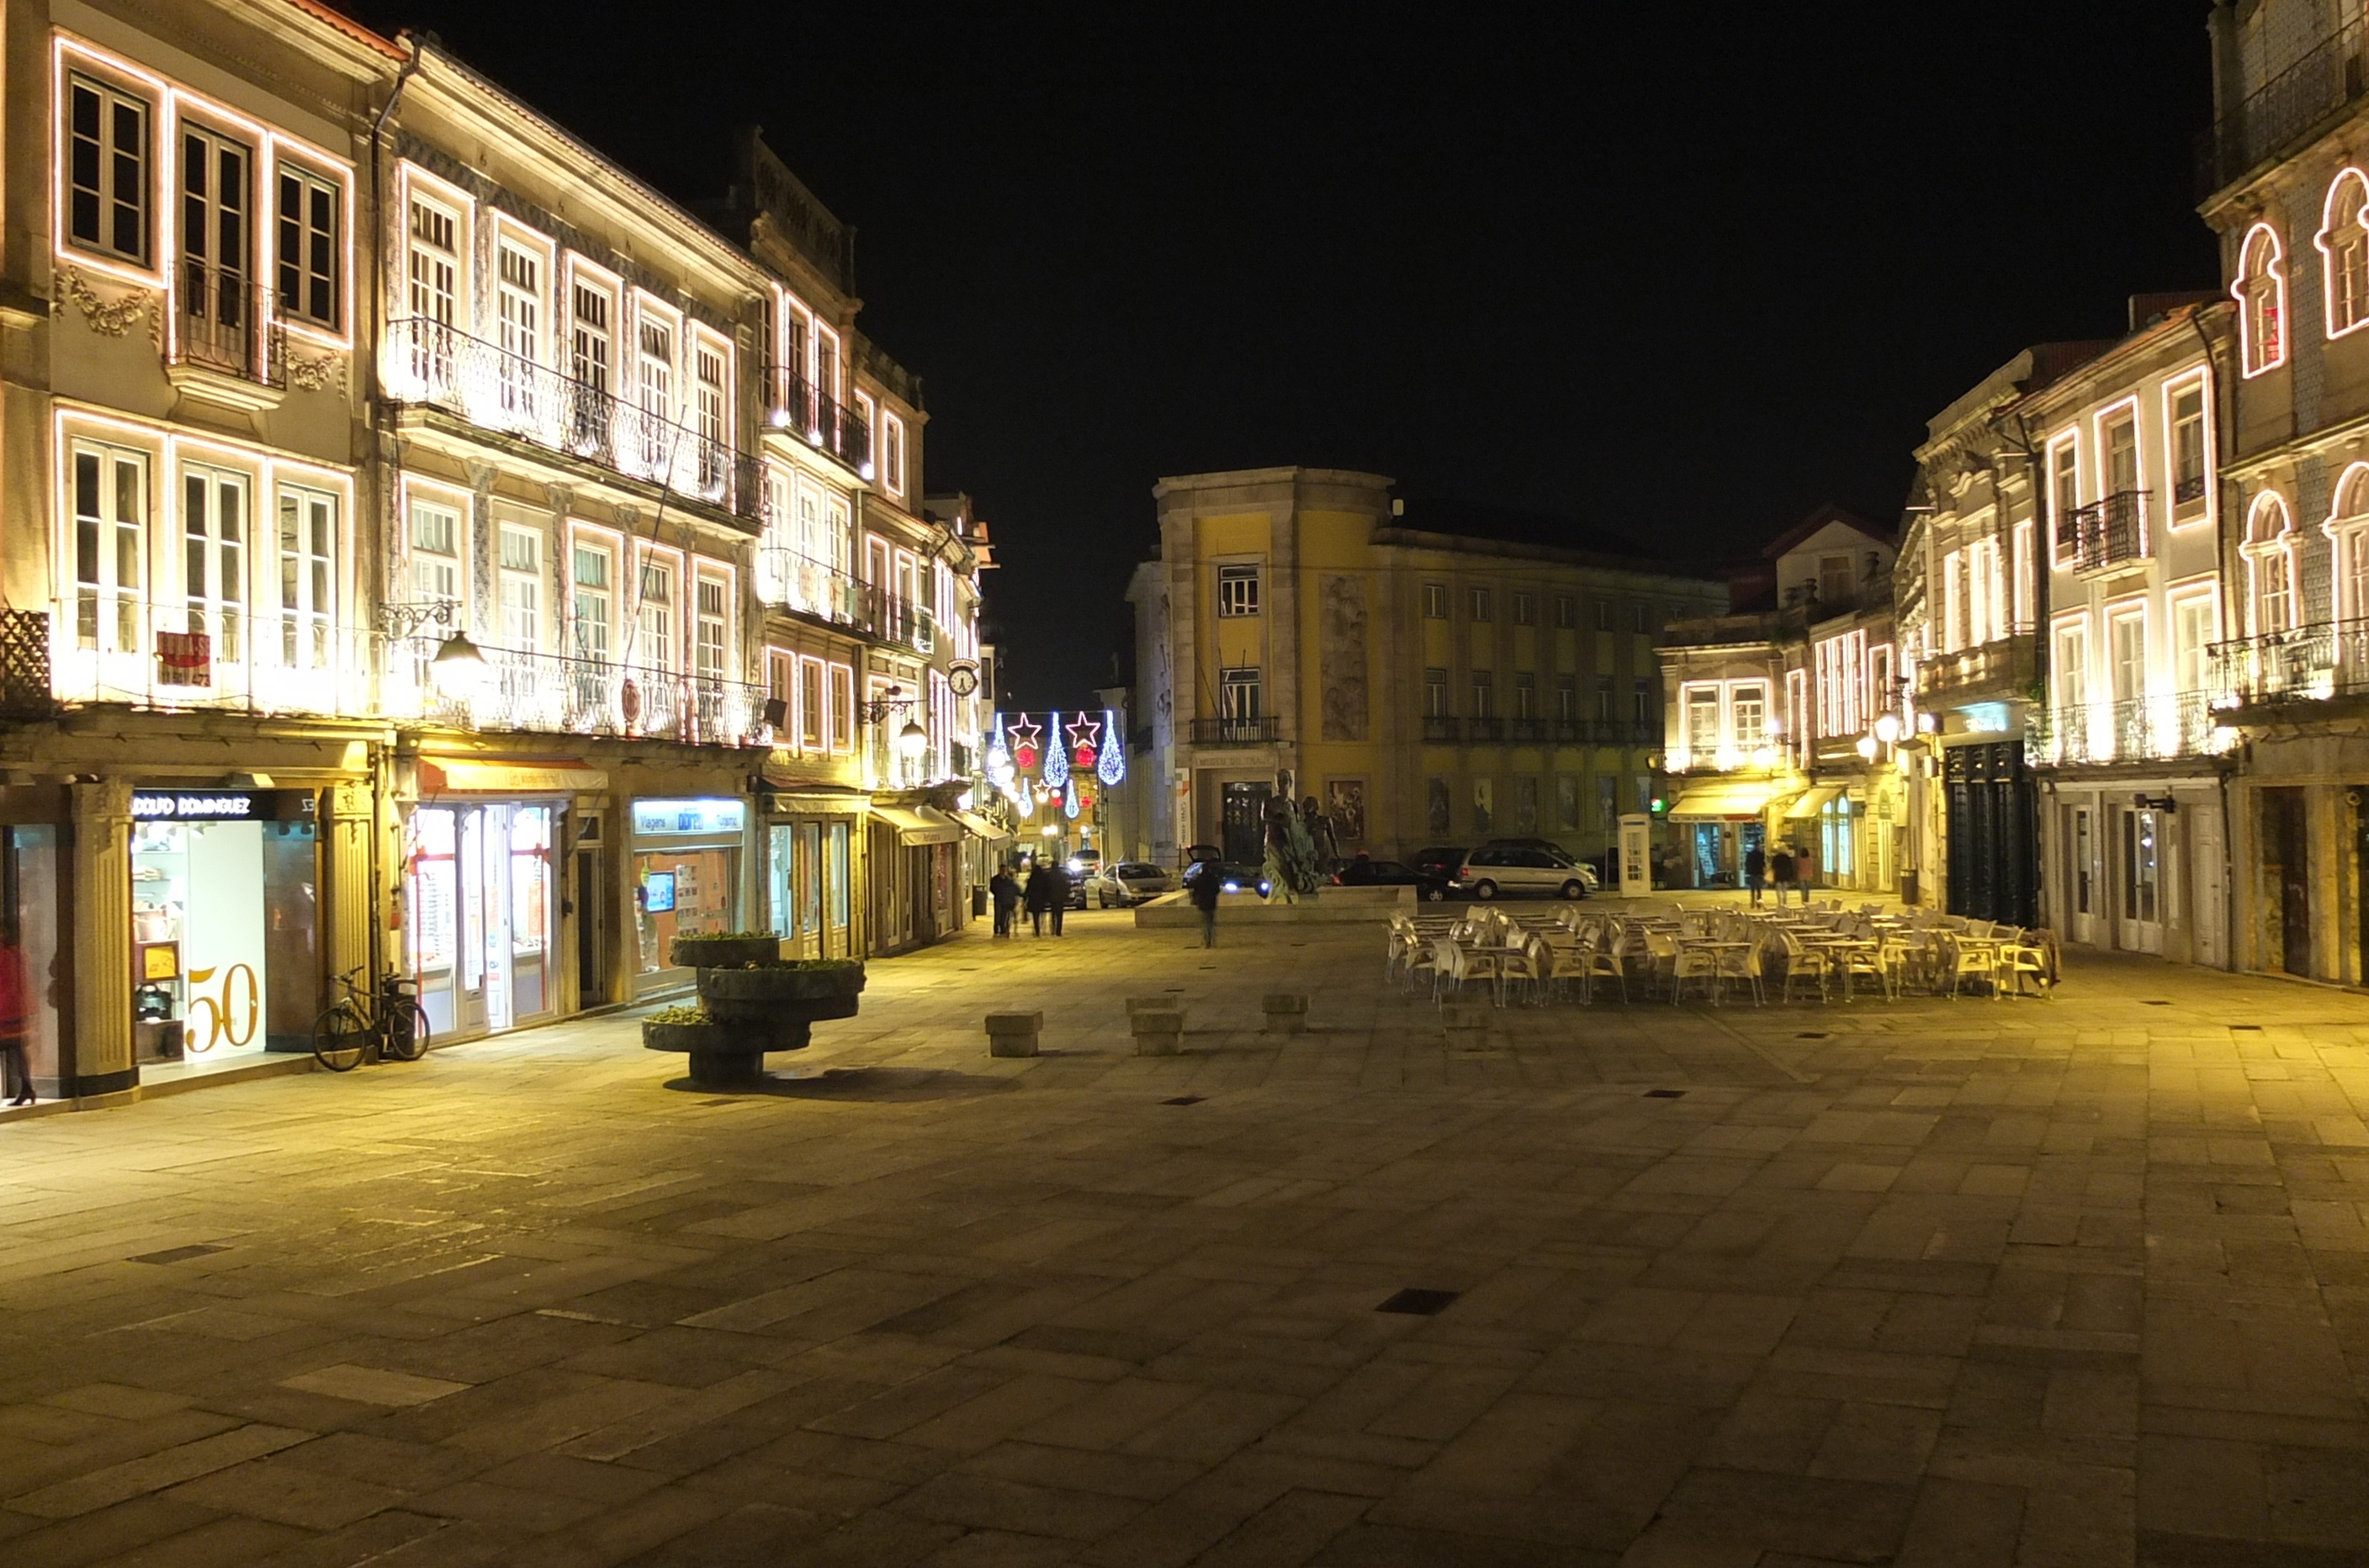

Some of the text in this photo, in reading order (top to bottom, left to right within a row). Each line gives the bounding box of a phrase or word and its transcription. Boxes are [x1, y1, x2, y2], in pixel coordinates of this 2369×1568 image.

[131, 797, 251, 815] DOLFO DOMINGUEZ
[185, 963, 258, 1053] 50
